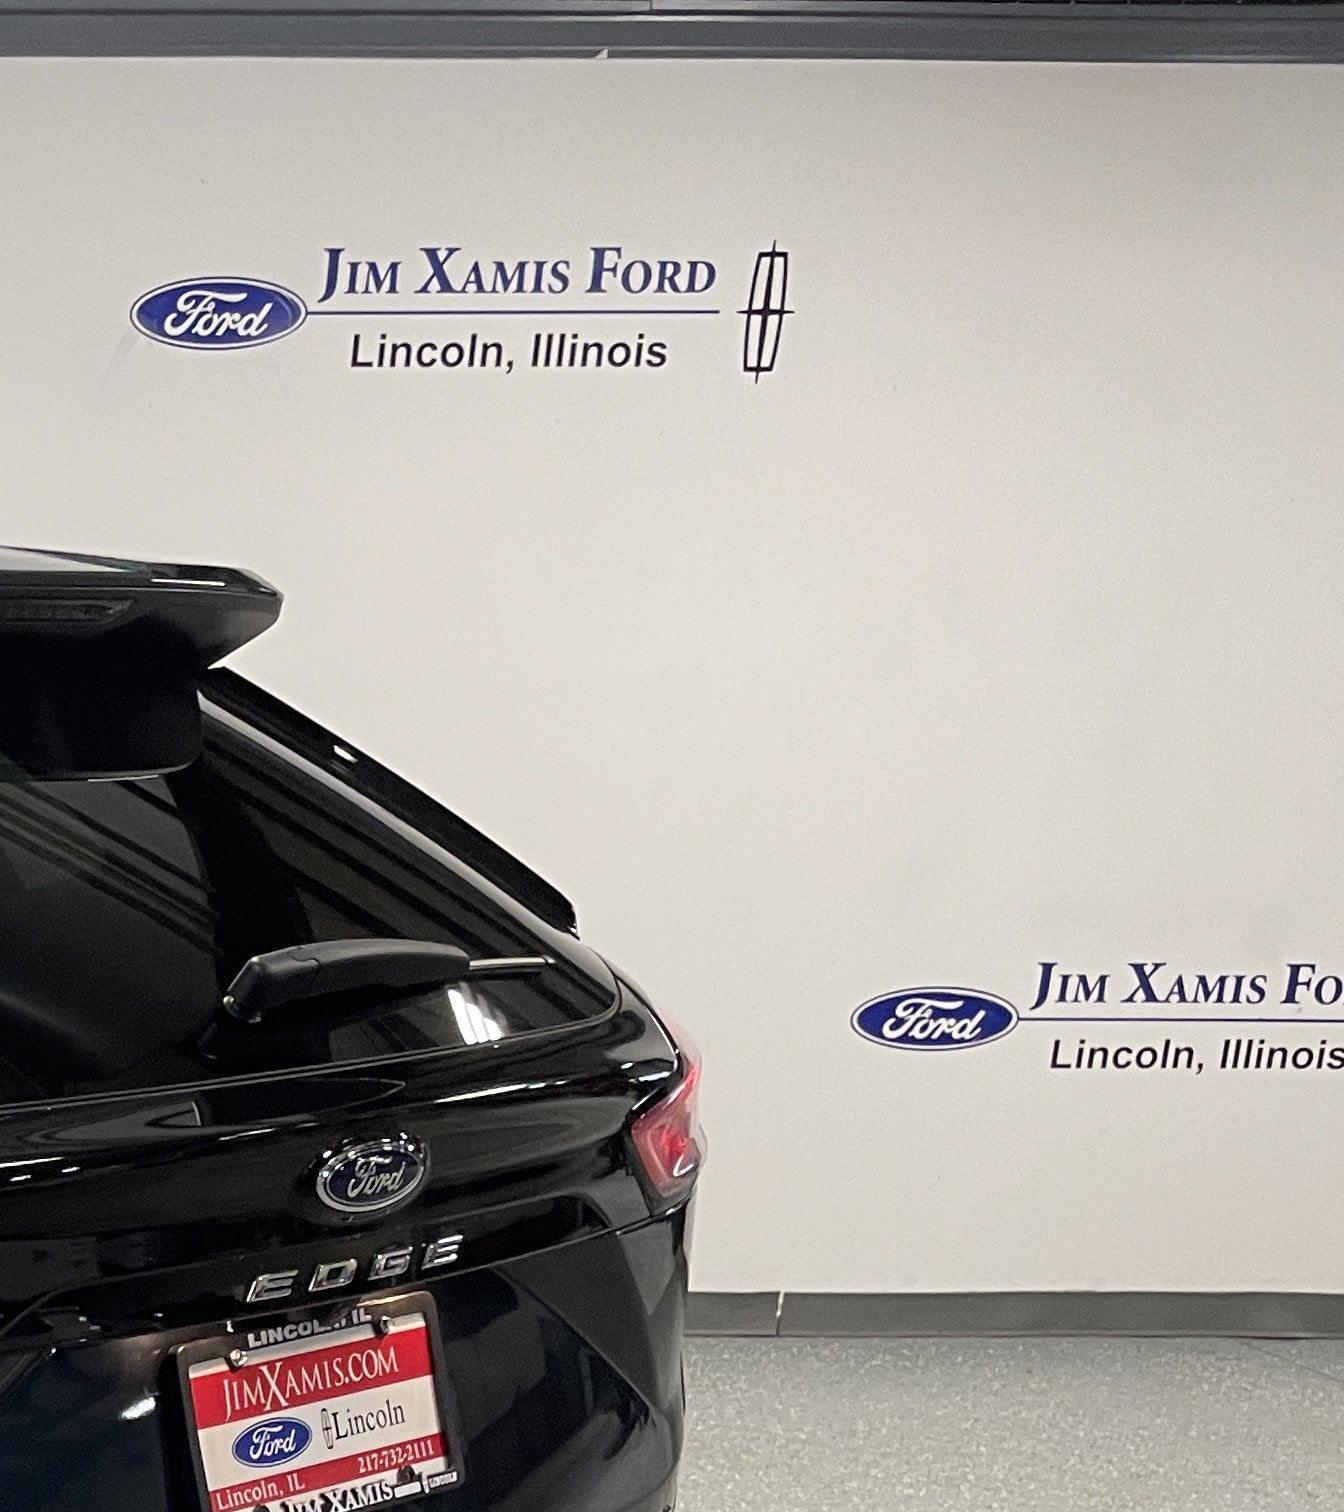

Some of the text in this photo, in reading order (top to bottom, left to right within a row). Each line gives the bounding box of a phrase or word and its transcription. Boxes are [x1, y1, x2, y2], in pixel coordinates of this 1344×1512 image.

[316, 246, 716, 304] JIM XAMIS FORD
[163, 289, 273, 339] Ford
[350, 333, 667, 374] Lincoln, Illinois
[1029, 962, 1344, 1011] JIM XAMIS FO
[881, 997, 986, 1040] Ford
[1050, 1038, 1344, 1075] Lincoln, Illinois
[346, 1154, 407, 1199] Ford
[246, 1234, 464, 1303] EDGE
[246, 1306, 372, 1349] LINCOL, IL
[222, 1346, 400, 1422] JIMXAMIS.COM
[331, 1398, 406, 1440] Lincoln
[248, 1424, 297, 1460] Ford
[357, 1440, 435, 1475] 217-732-2111
[216, 1472, 306, 1511] Lincoln, IL
